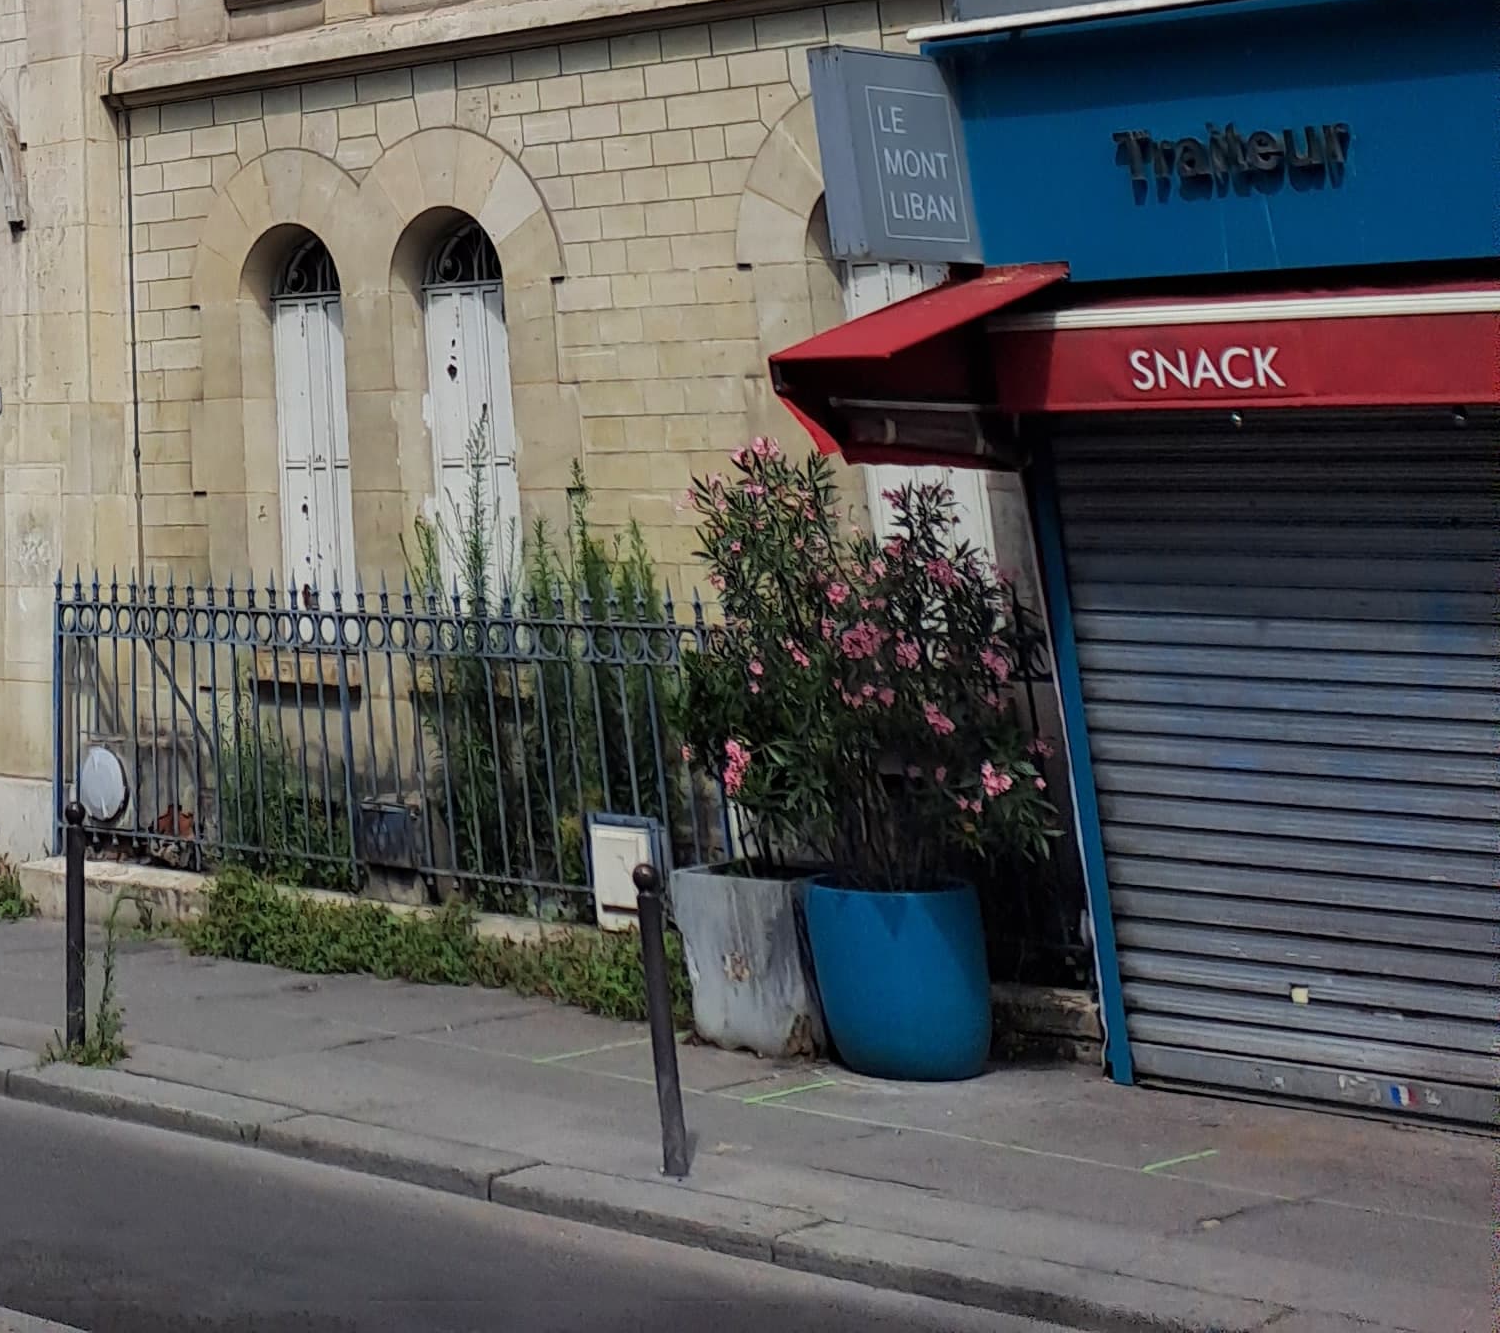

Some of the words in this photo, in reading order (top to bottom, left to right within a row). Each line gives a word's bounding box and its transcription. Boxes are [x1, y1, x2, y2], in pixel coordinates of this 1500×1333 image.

[877, 105, 907, 133] LE
[884, 147, 948, 180] MONT
[1112, 122, 1350, 183] Traiteur
[890, 190, 957, 223] LIBAN
[1129, 346, 1287, 391] SNACK
